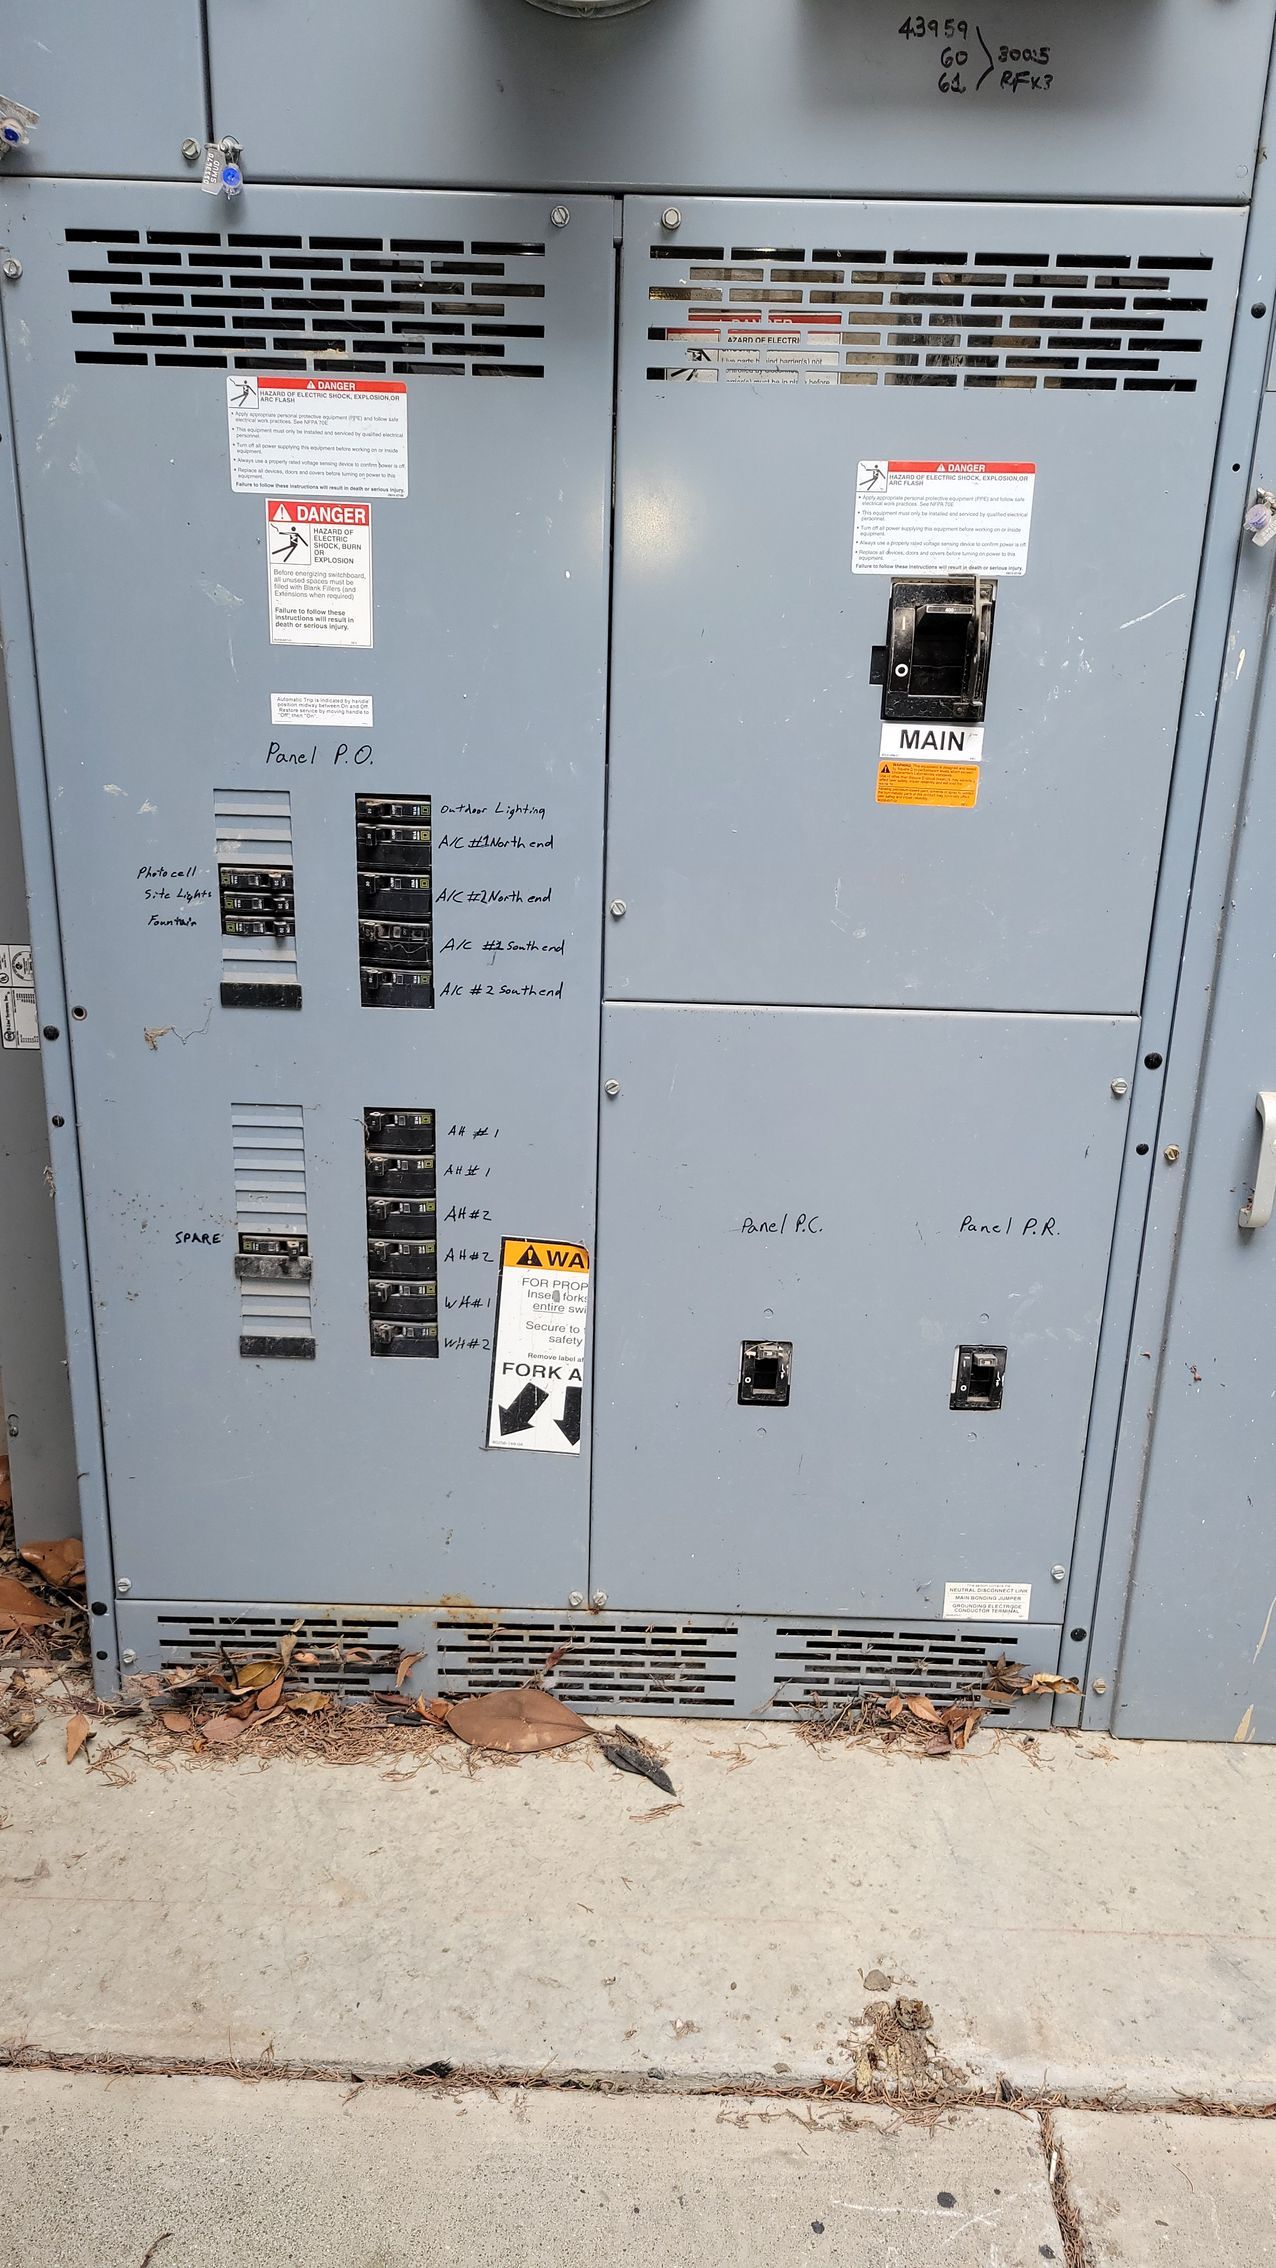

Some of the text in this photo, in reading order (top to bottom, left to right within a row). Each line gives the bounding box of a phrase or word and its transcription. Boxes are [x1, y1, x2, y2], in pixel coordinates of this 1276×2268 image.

[899, 16, 968, 40] 43959
[941, 46, 968, 68] 60
[938, 72, 967, 93] 61
[211, 160, 220, 184] SMUD
[318, 381, 355, 391] DANGER
[948, 463, 985, 472] DANGER
[297, 505, 366, 524] DANGER
[295, 570, 327, 578] energizing
[328, 571, 367, 580] switchboard,
[900, 729, 965, 751] MAIN
[266, 741, 373, 765] Panel P.O.
[440, 802, 546, 820] Outdoor Lighting
[145, 887, 212, 904] Site Lights
[148, 914, 197, 927] Fountain
[448, 1125, 466, 1136] AH
[443, 1164, 463, 1176] AH
[741, 1213, 823, 1234] Panel P.C.
[960, 1215, 1060, 1236] Panel P.R.
[175, 1231, 222, 1245] SPARE
[547, 1250, 589, 1269] WA
[522, 1278, 549, 1288] FOR
[533, 1302, 565, 1312] entire
[526, 1321, 580, 1334] Secure to
[548, 1335, 583, 1347] safety
[528, 1352, 557, 1360] Remove
[558, 1354, 576, 1362] label
[502, 1362, 582, 1382] FORK A
